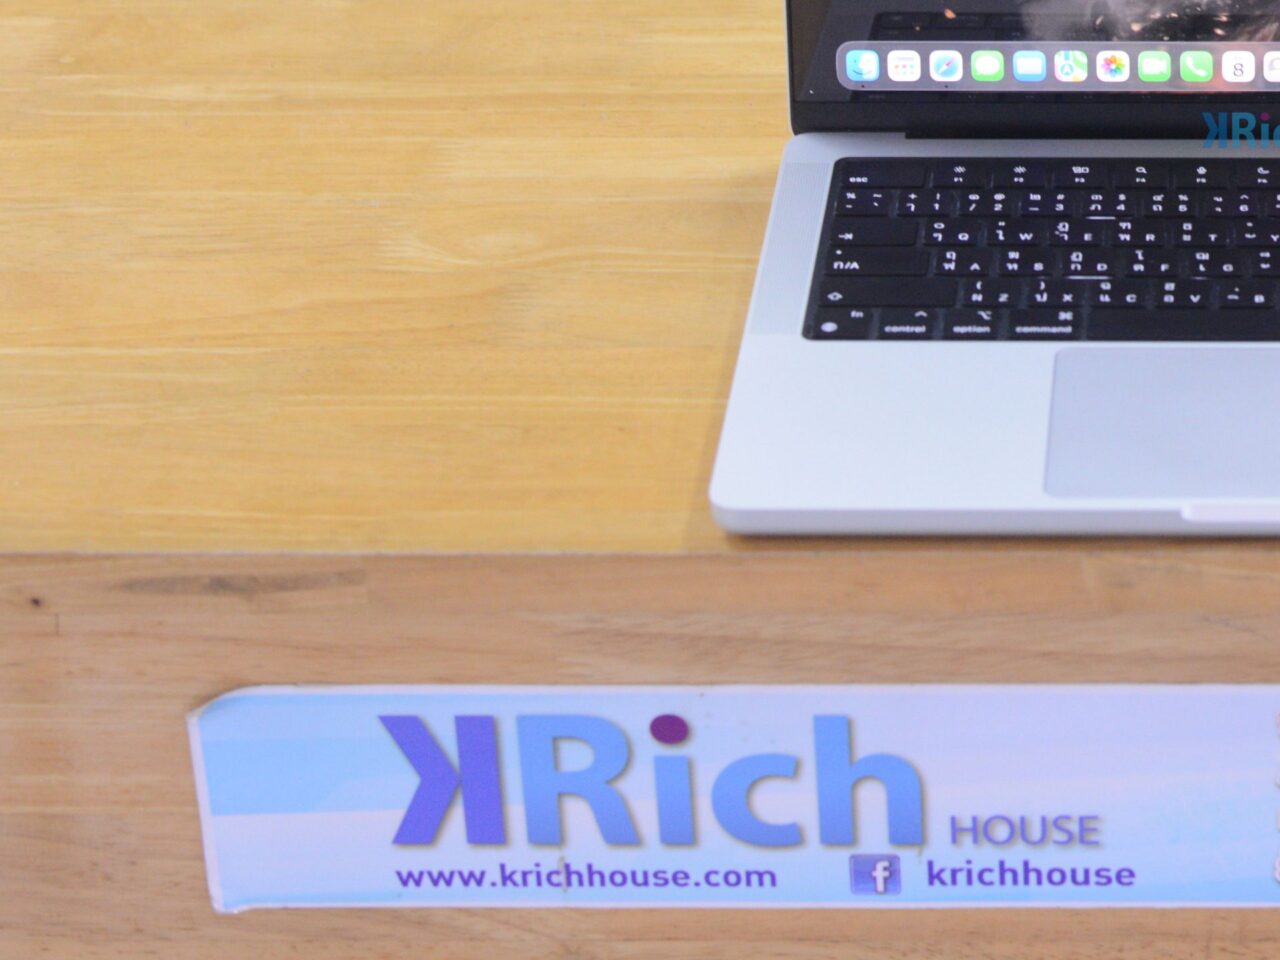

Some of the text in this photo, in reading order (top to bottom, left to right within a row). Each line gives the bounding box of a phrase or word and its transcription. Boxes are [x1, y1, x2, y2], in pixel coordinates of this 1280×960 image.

[884, 325, 927, 334] control
[952, 325, 991, 334] option
[1015, 325, 1073, 334] command
[378, 713, 1101, 847] KRich HOUSE
[395, 862, 778, 888] www.krichhouse.com
[926, 859, 1136, 887] krichhouse
